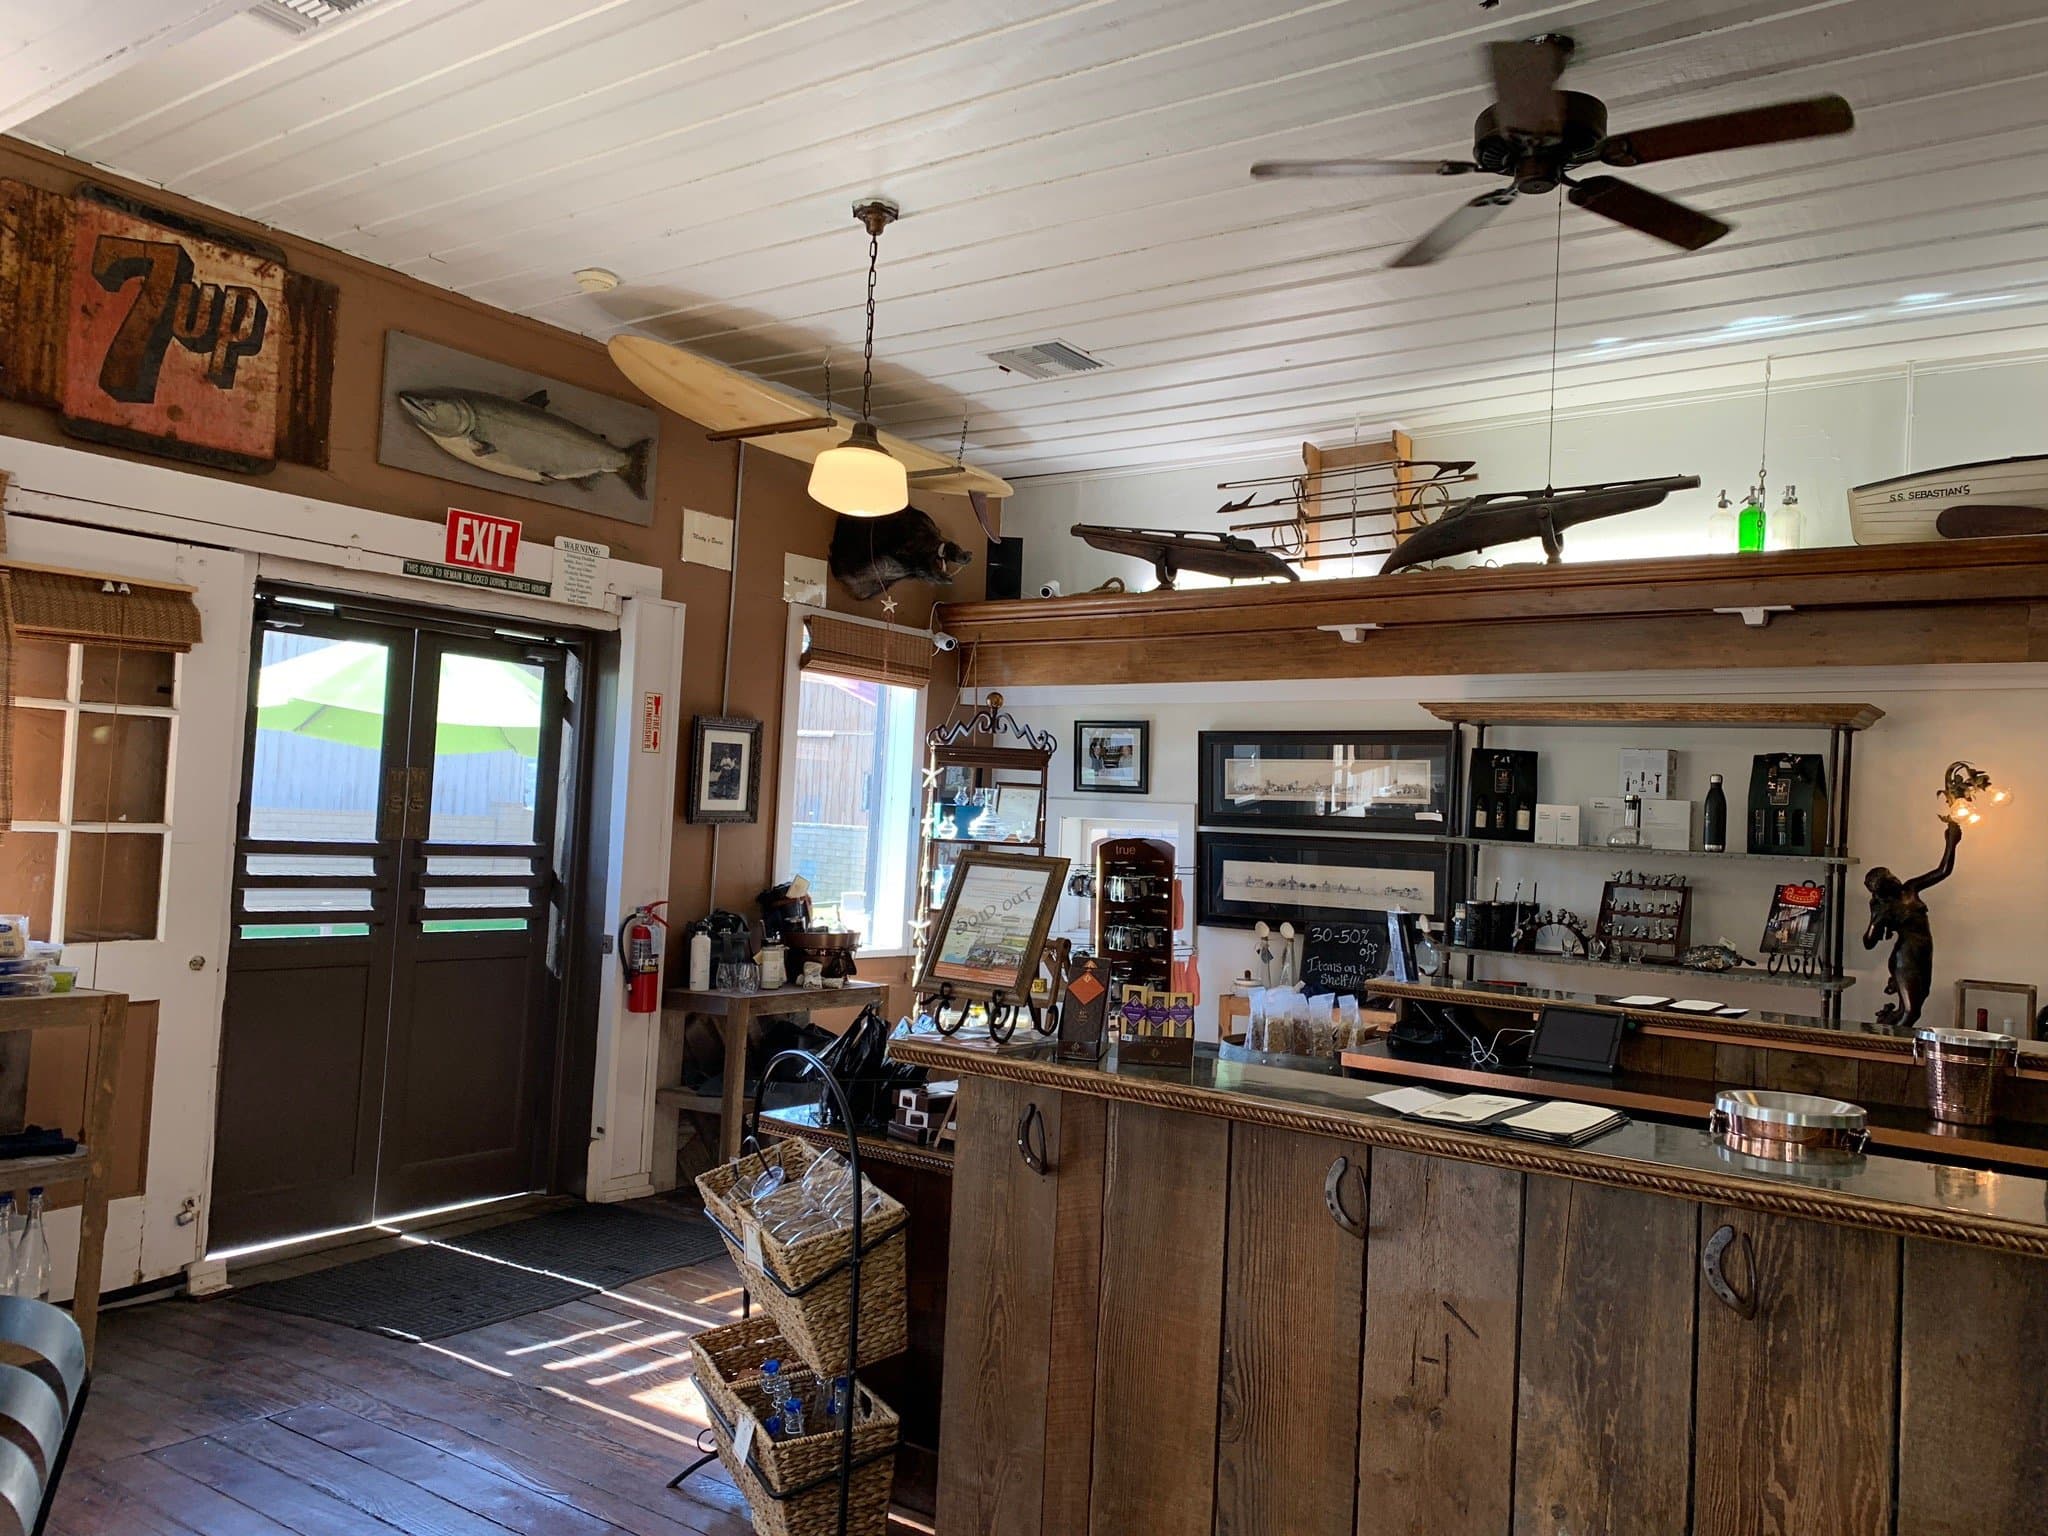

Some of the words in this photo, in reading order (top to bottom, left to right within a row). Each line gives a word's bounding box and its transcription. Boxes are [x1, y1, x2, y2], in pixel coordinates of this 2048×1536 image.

[1908, 484, 1970, 500] SEBASTIAN'S
[455, 517, 513, 568] EXIT
[406, 562, 418, 573] THIS
[420, 565, 433, 576] DOOR
[435, 567, 442, 577] TO
[463, 572, 489, 586] UNLOCKED
[1115, 845, 1136, 856] true
[1311, 927, 1370, 945] 30-50%
[1359, 943, 1378, 964] off
[1344, 964, 1357, 975] on
